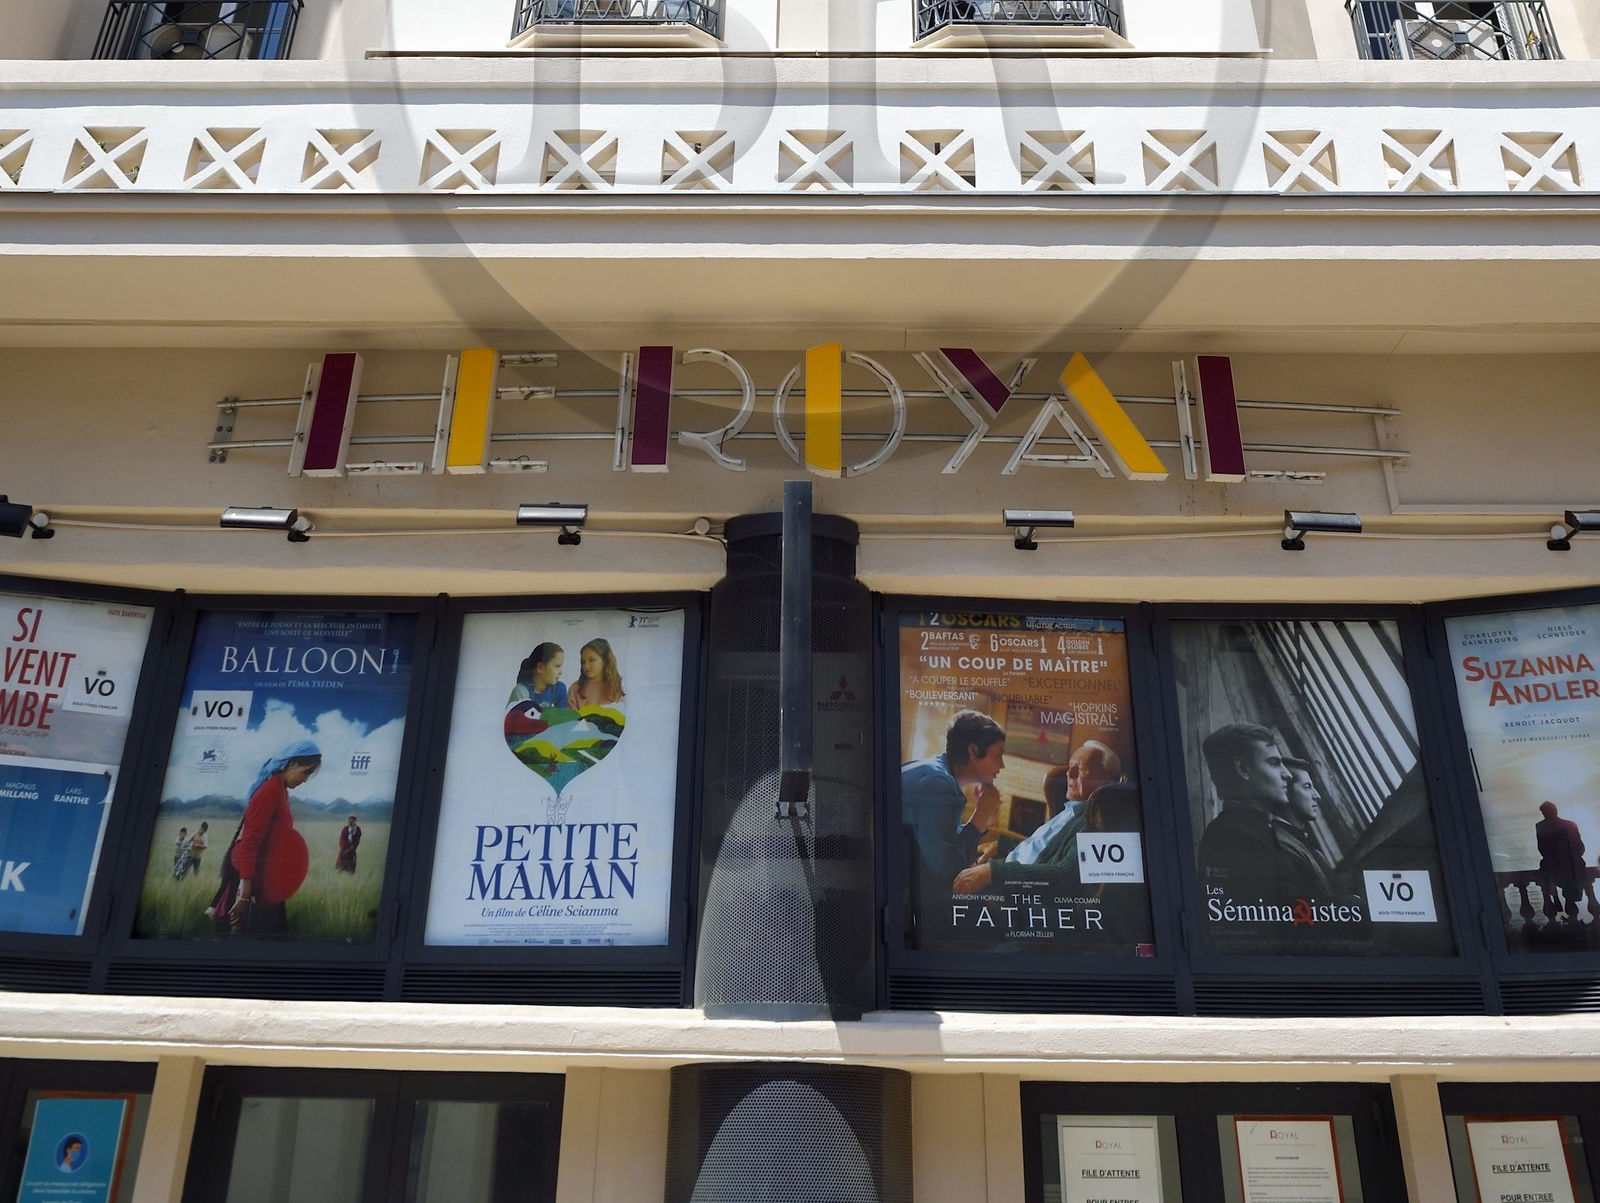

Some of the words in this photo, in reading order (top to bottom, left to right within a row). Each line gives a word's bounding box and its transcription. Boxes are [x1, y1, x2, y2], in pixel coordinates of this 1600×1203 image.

[612, 343, 1325, 484] ROYAL
[12, 607, 43, 643] SI
[942, 613, 1021, 628] OSCARS
[920, 631, 929, 650] 2
[929, 632, 964, 640] BAFTAS
[1464, 630, 1513, 640] CHARLOTTE
[1537, 630, 1586, 639] SCHNEIDER
[990, 633, 999, 652] 6
[1000, 637, 1039, 647] OSCARS
[1057, 636, 1066, 654] 4
[1462, 636, 1518, 647] GAINSBOURG
[220, 646, 387, 675] BALLOON
[958, 657, 1006, 670] COUP
[1013, 658, 1033, 671] DE
[4, 647, 77, 688] VENT
[1462, 653, 1595, 682] SUZANNA
[921, 675, 958, 685] COUPER
[960, 677, 969, 685] LE
[84, 677, 115, 697] VO
[1489, 679, 1600, 707] ANDLER
[204, 701, 233, 717] VO
[1540, 717, 1580, 726] JACQUOT
[351, 756, 371, 769] tiff
[5, 782, 37, 791] MAGNUS
[65, 787, 82, 795] LARS
[0, 790, 39, 800] MILLANG
[54, 795, 90, 805] RANTHE
[472, 823, 638, 862] PETITE
[1091, 844, 1124, 863] VO
[466, 861, 639, 901] MAMAN
[1206, 885, 1224, 895] Les
[1379, 882, 1414, 901] VO
[1012, 894, 1042, 905] THE
[1074, 897, 1100, 905] COLMAN
[481, 908, 494, 917] Un
[494, 907, 514, 919] film
[515, 907, 527, 917] de
[528, 905, 563, 917] Céline
[564, 905, 618, 917] Sciamma
[952, 905, 1104, 930] FATHER
[1270, 1129, 1300, 1140] ROYAL
[1502, 1135, 1528, 1144] ROYAL
[1095, 1140, 1122, 1149] ROYAL
[1082, 1169, 1098, 1177] FILE
[1492, 1164, 1508, 1172] FILE
[1510, 1163, 1550, 1171] D'ATTENTE
[1500, 1194, 1522, 1202] POUR
[1524, 1193, 1553, 1202] ENTREE
